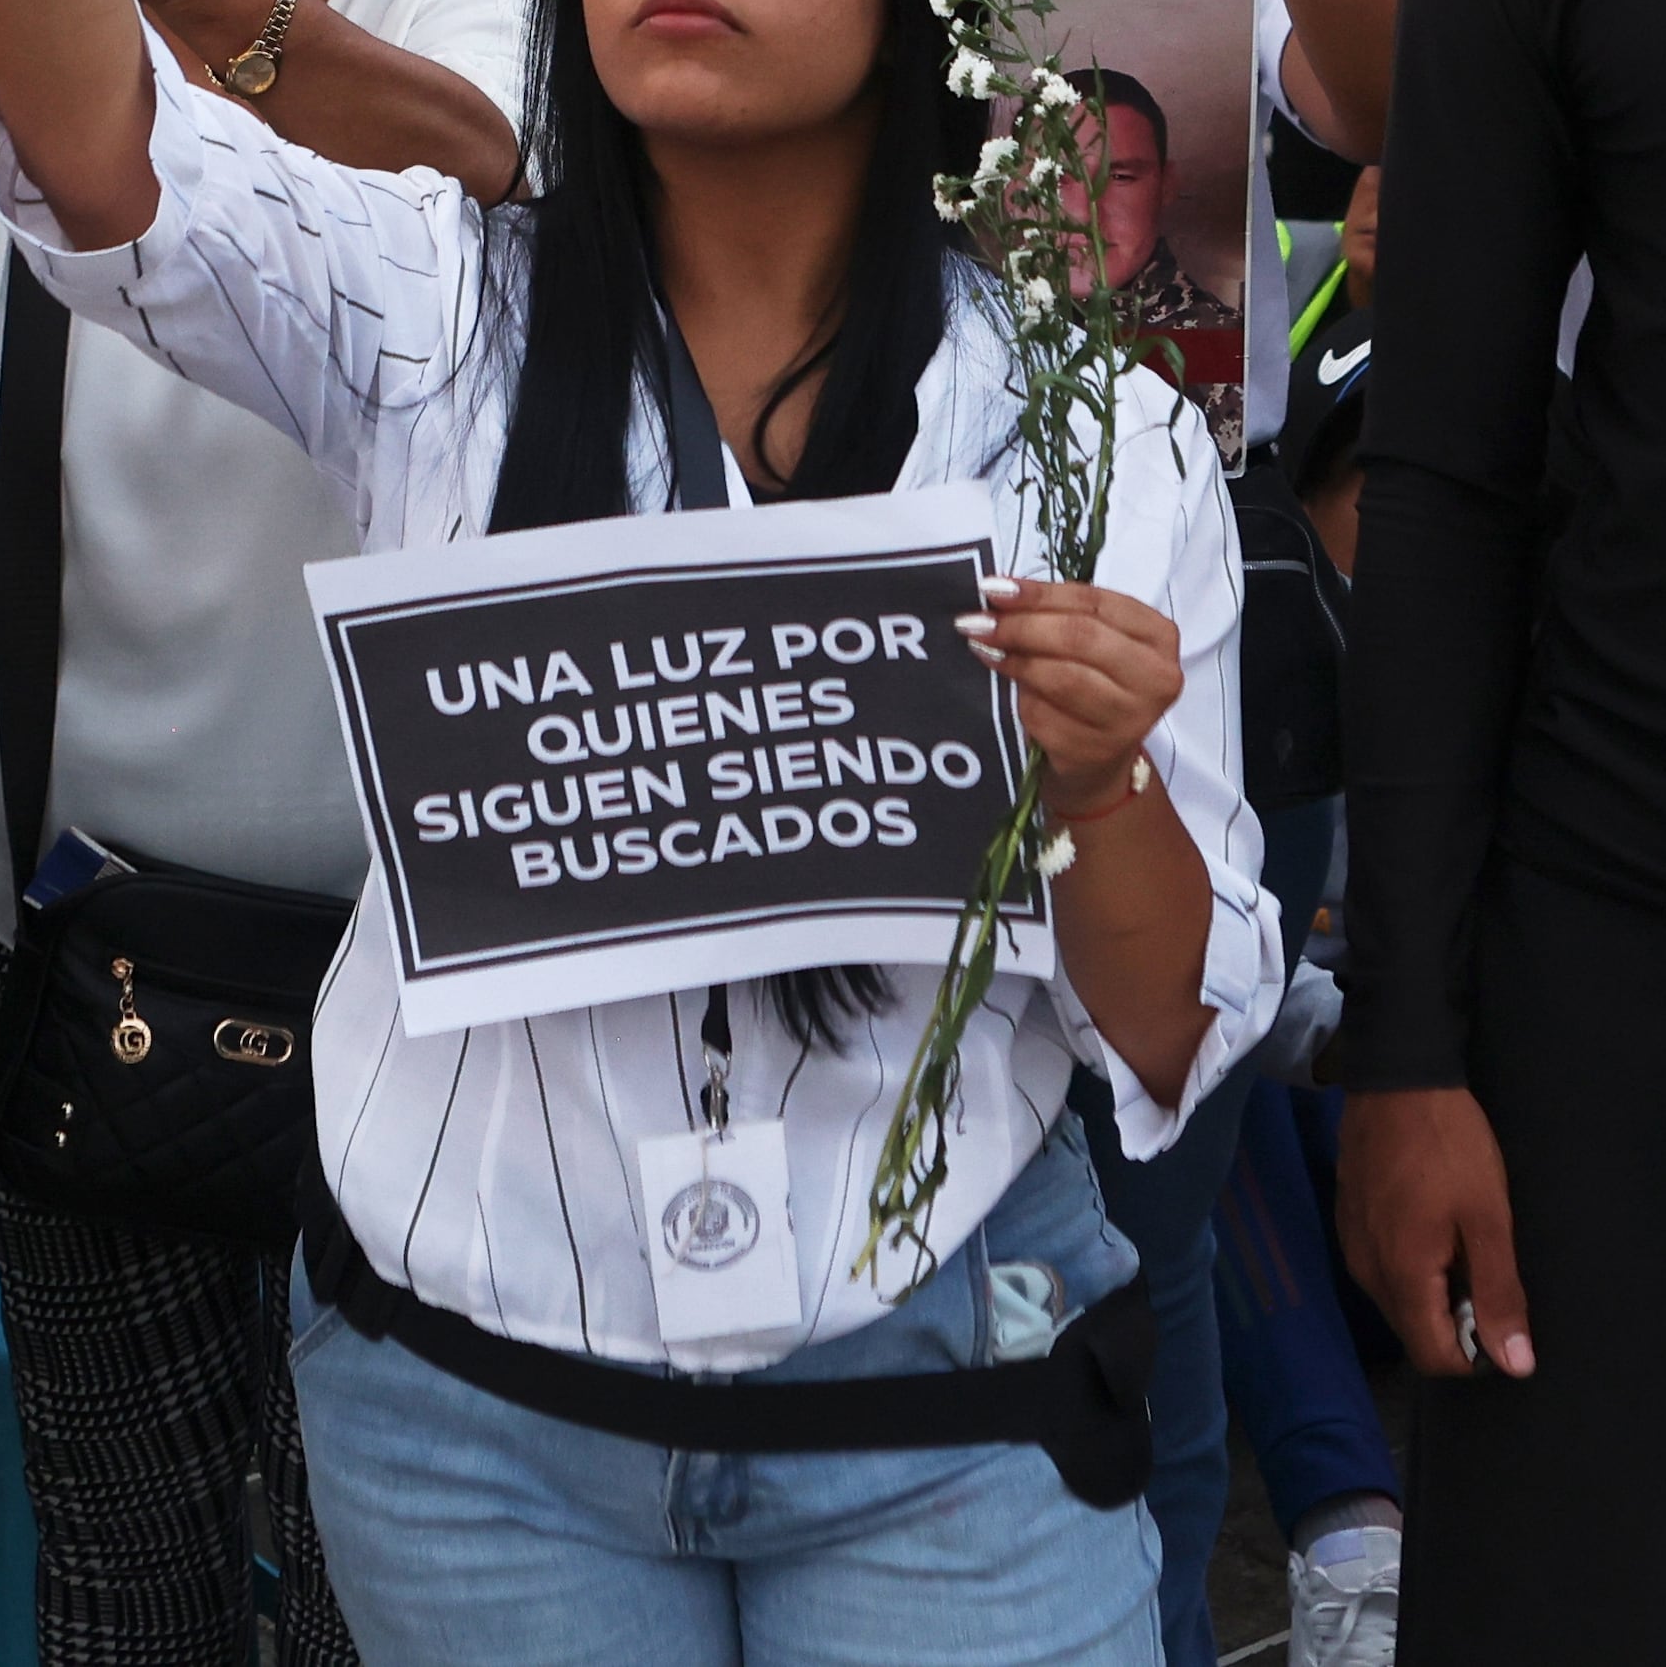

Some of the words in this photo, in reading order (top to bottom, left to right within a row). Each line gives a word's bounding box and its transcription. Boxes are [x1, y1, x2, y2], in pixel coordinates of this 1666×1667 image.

[425, 650, 593, 716] UNA
[610, 627, 754, 690] LUZ
[771, 613, 929, 670] POR
[527, 677, 856, 764] QUIENES
[413, 760, 687, 842] SIGUEN
[707, 735, 982, 801] SIENDO
[510, 796, 918, 889] BUSCADOS
